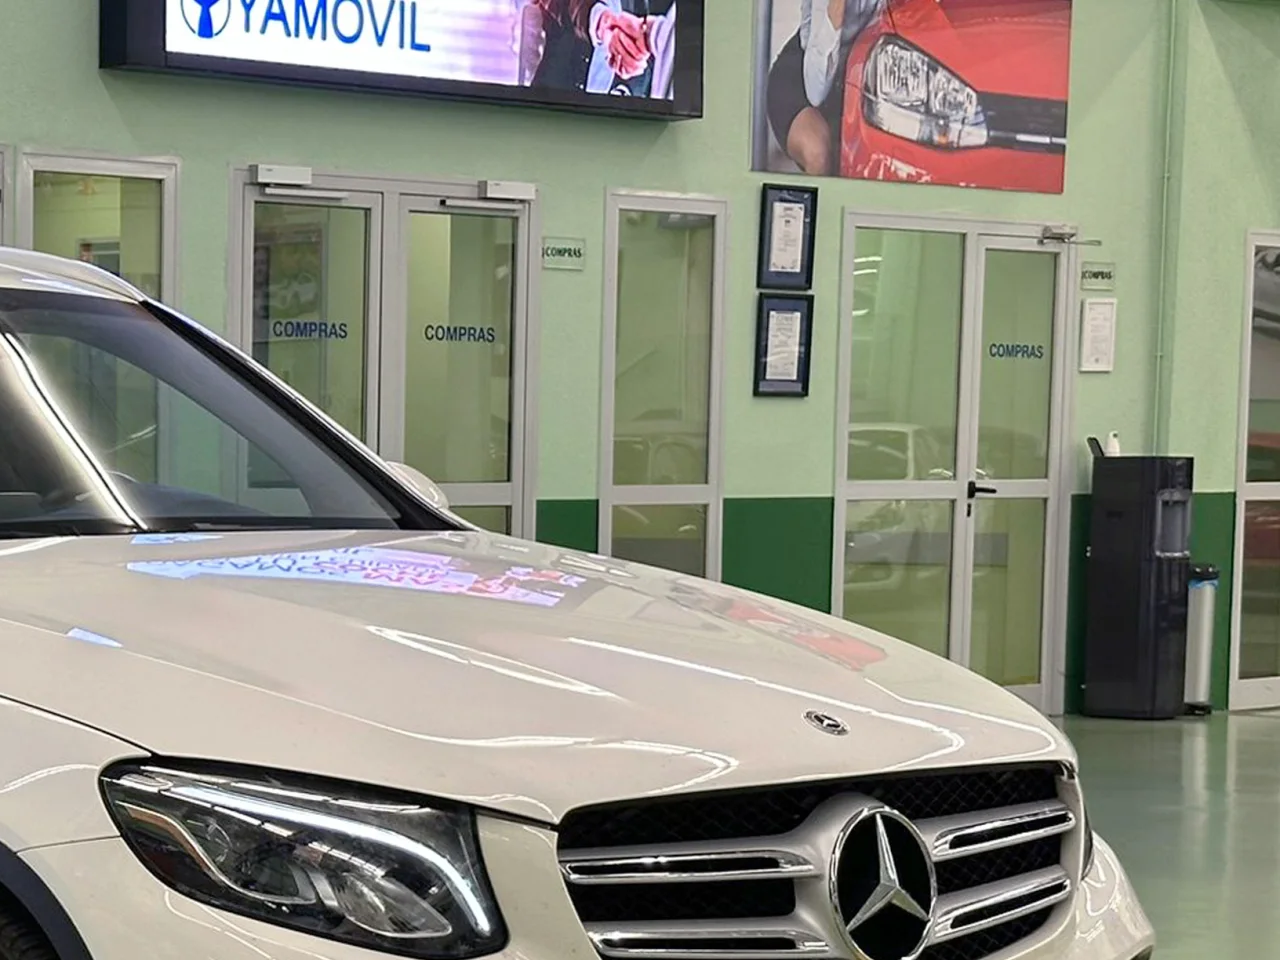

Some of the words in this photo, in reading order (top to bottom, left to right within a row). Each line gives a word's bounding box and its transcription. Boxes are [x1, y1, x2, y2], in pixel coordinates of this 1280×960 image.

[239, 0, 431, 52] YAMOVIL
[272, 320, 349, 340] COMPRAS
[424, 324, 496, 344] COMPRAS
[989, 342, 1045, 360] COMPRAS
